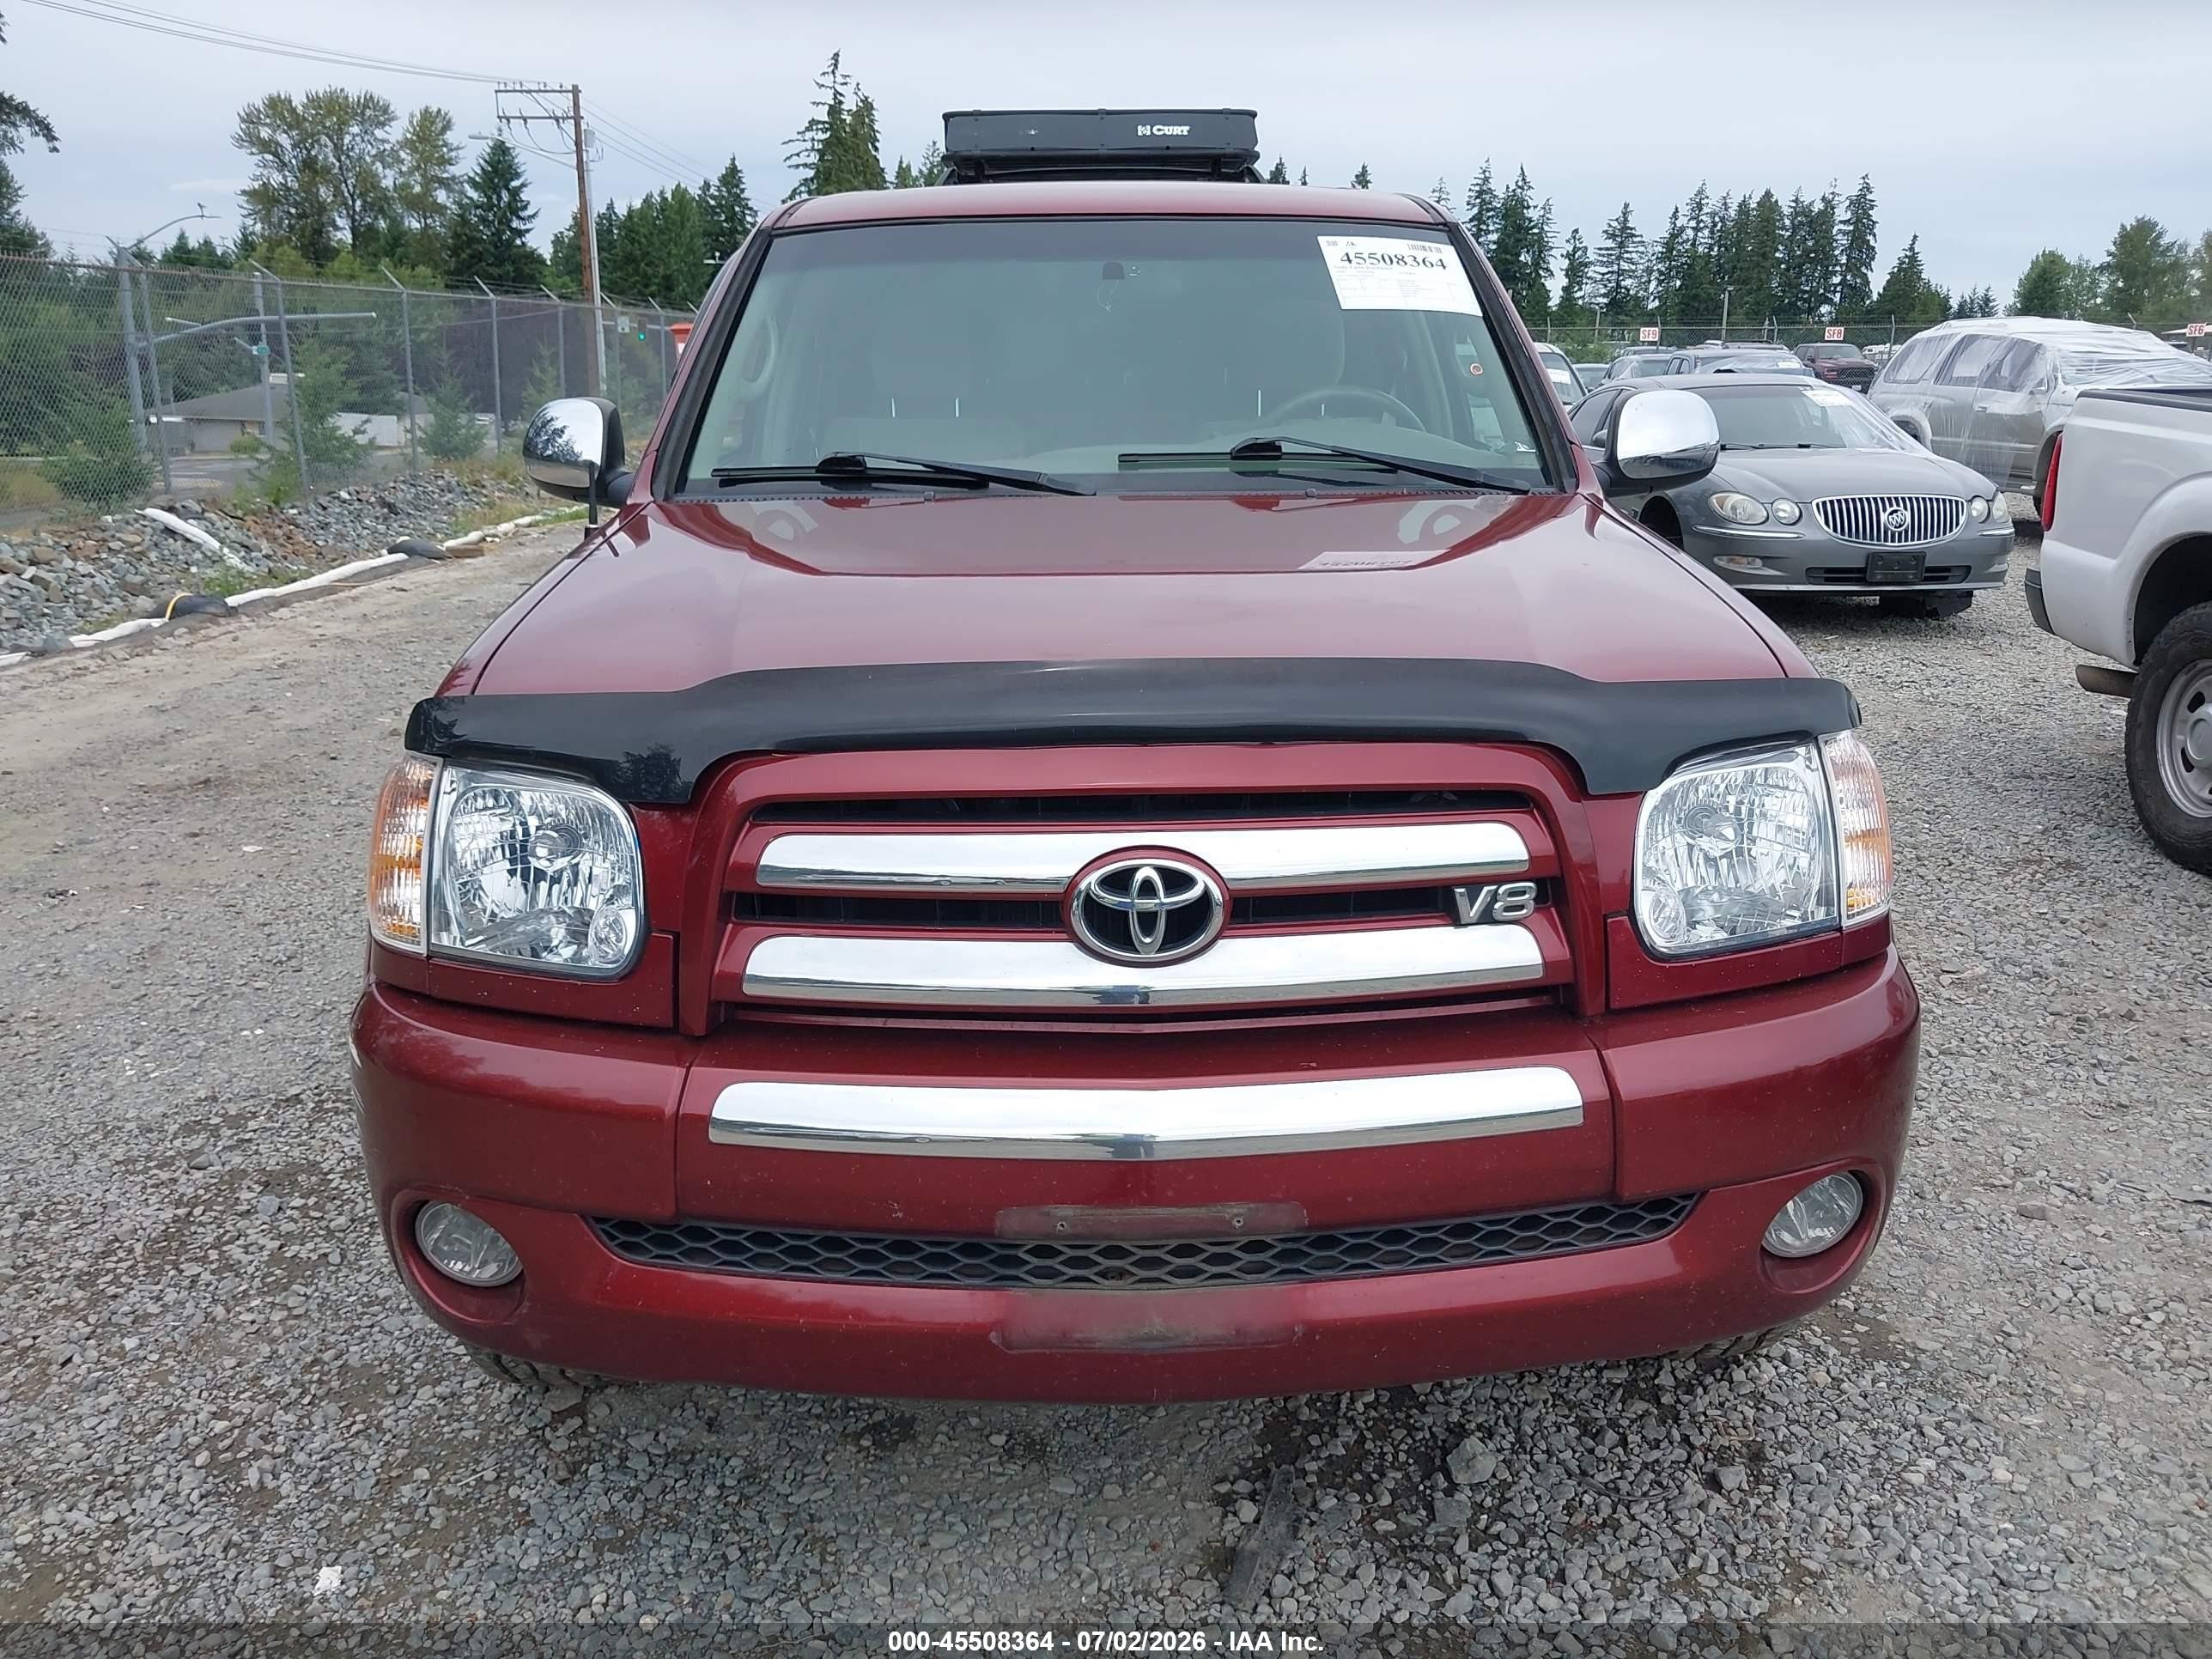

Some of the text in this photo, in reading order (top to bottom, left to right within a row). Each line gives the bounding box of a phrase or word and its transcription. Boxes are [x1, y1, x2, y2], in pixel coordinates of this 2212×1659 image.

[1152, 125, 1190, 136] CURT
[1340, 252, 1447, 270] 45508364
[1641, 329, 1657, 340] SF9
[1826, 328, 1843, 339] SF8
[2188, 325, 2204, 336] SF6
[1454, 882, 1537, 925] V8
